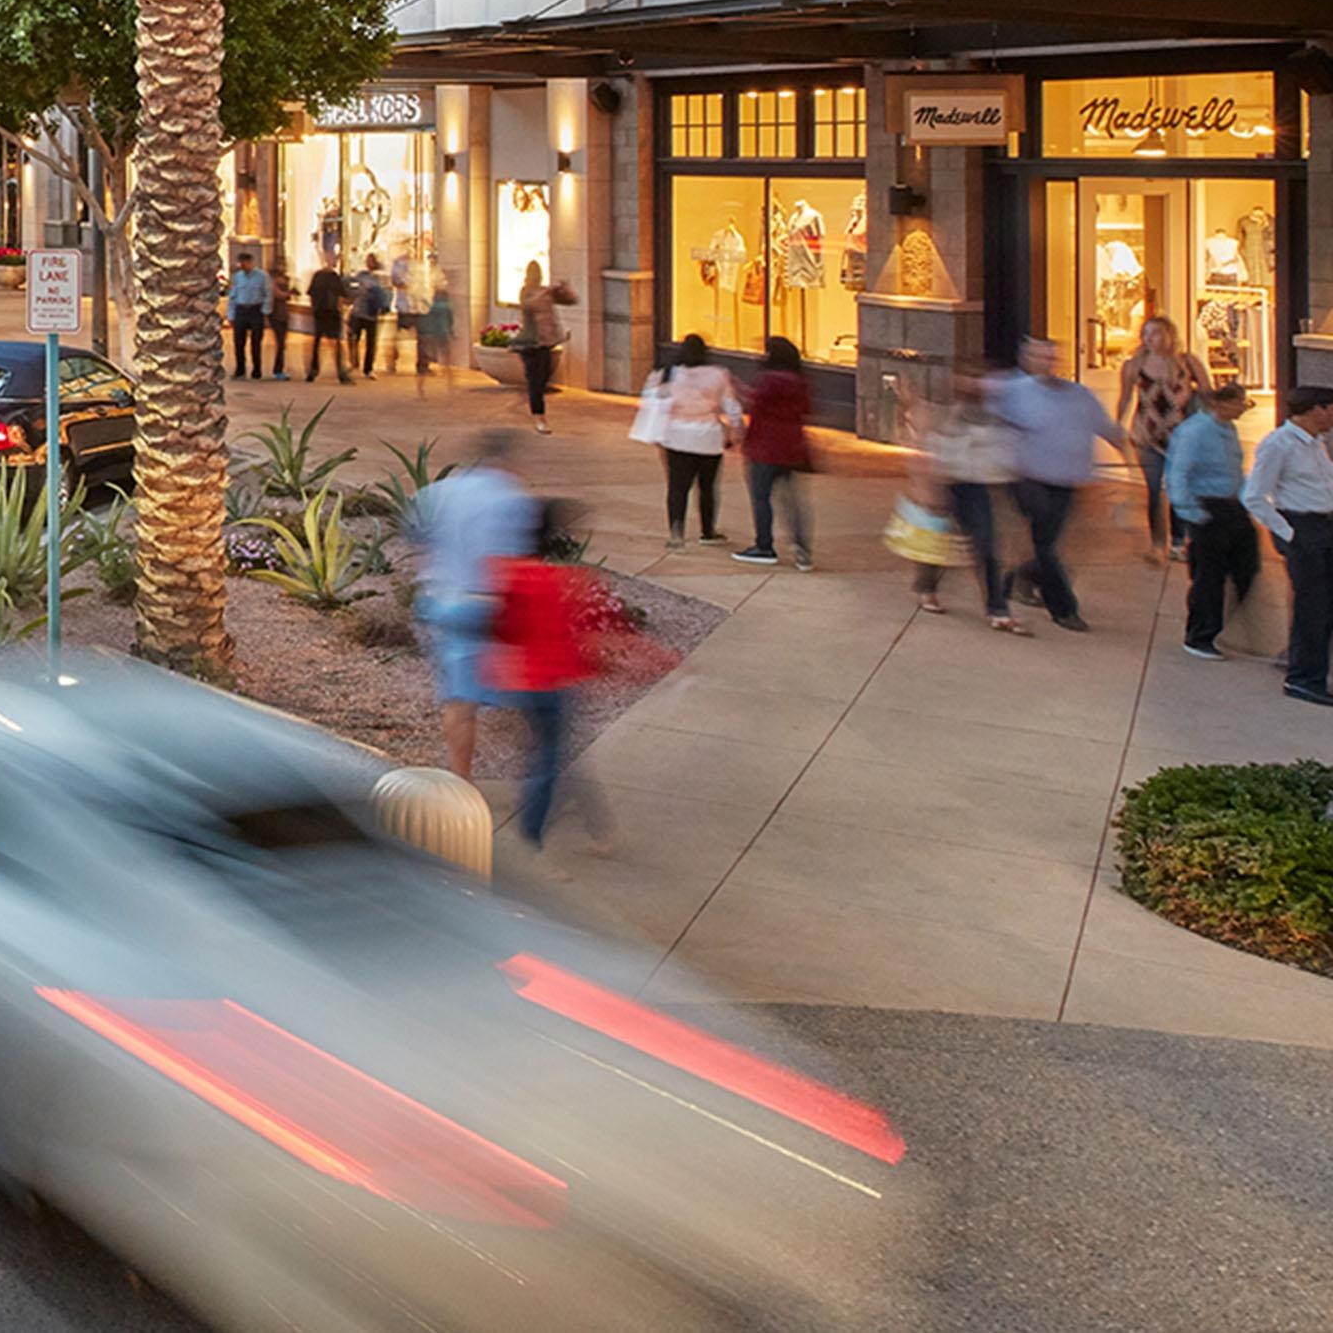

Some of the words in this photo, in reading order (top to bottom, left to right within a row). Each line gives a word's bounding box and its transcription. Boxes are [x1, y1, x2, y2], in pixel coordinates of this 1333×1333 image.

[370, 94, 421, 123] KORS
[914, 106, 1002, 129] Madewell
[1080, 97, 1237, 138] Madewell
[41, 257, 67, 267] FIRE
[39, 270, 69, 282] LANE
[36, 296, 72, 305] PARKING
